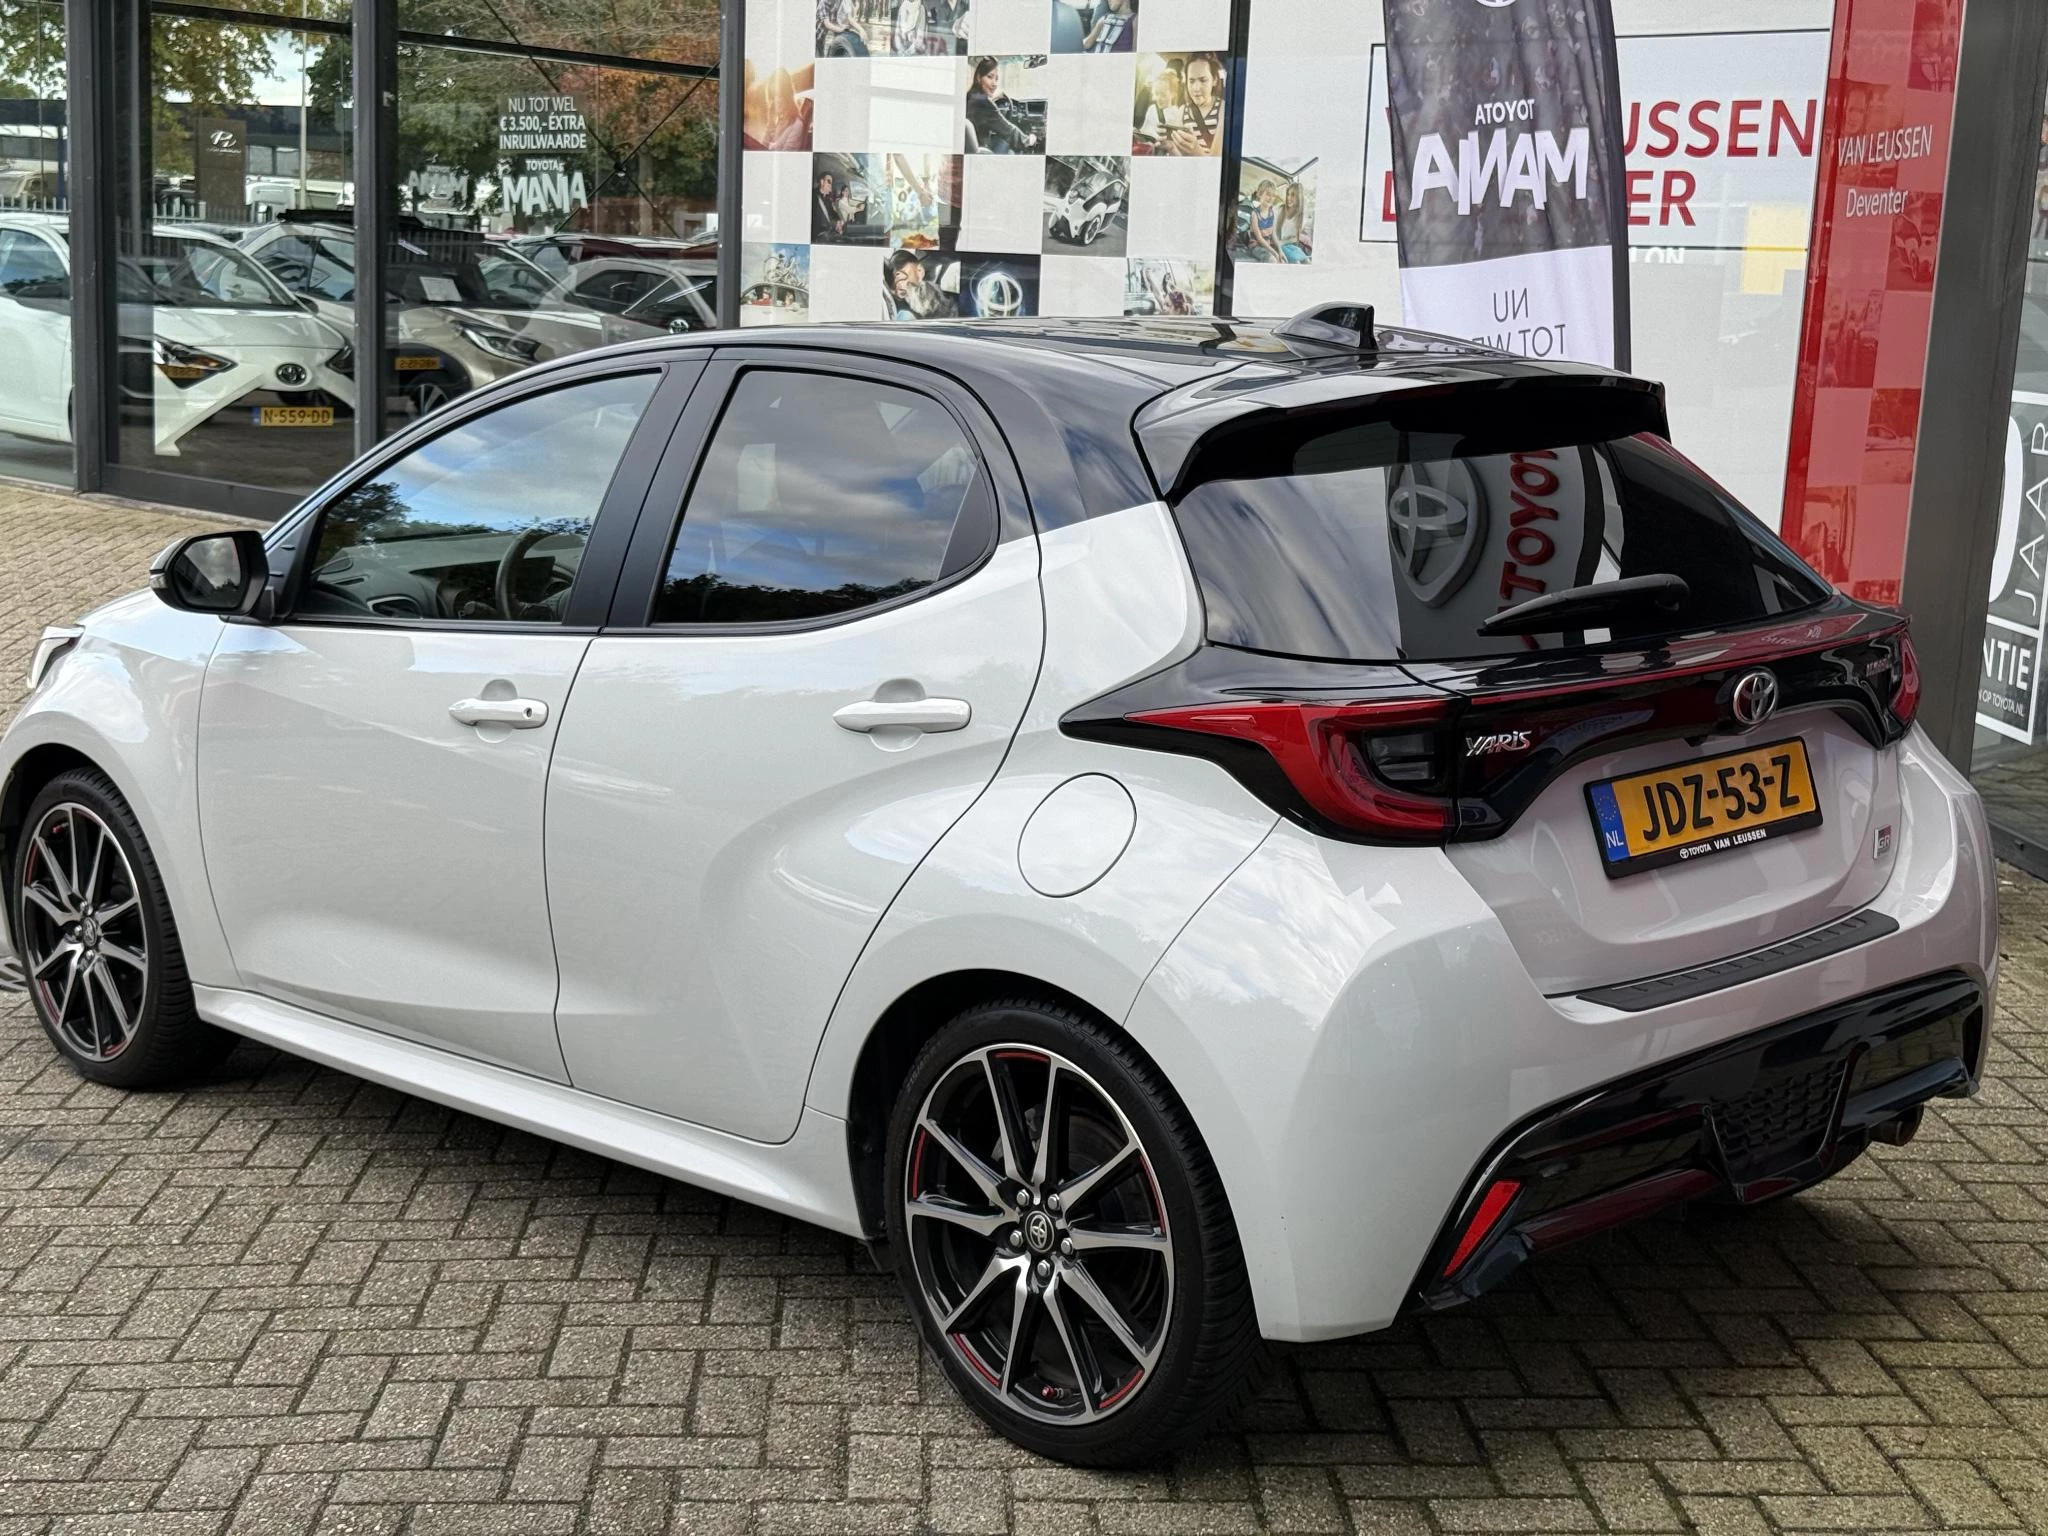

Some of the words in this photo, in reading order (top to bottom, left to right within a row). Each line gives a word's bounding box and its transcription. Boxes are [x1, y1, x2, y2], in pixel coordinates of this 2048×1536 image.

[508, 98, 526, 112] NU
[528, 97, 550, 112] TOT
[551, 96, 578, 112] WEL
[500, 133, 587, 149] INRUILWAARDE
[1838, 134, 1866, 167] VAN
[1867, 124, 1933, 164] LEUSSEN
[525, 159, 559, 171] TOYOTA
[502, 171, 588, 216] MANIA
[1846, 186, 1909, 218] Deventer
[263, 408, 331, 424] N-559-DD
[1982, 638, 2031, 691] NTIE
[1643, 754, 1801, 842] JDZ-53-Z
[1605, 830, 1624, 849] NL
[1688, 843, 1712, 856] TOYOTA
[1714, 837, 1731, 850] VAN
[1733, 828, 1767, 846] LEUSSEN
